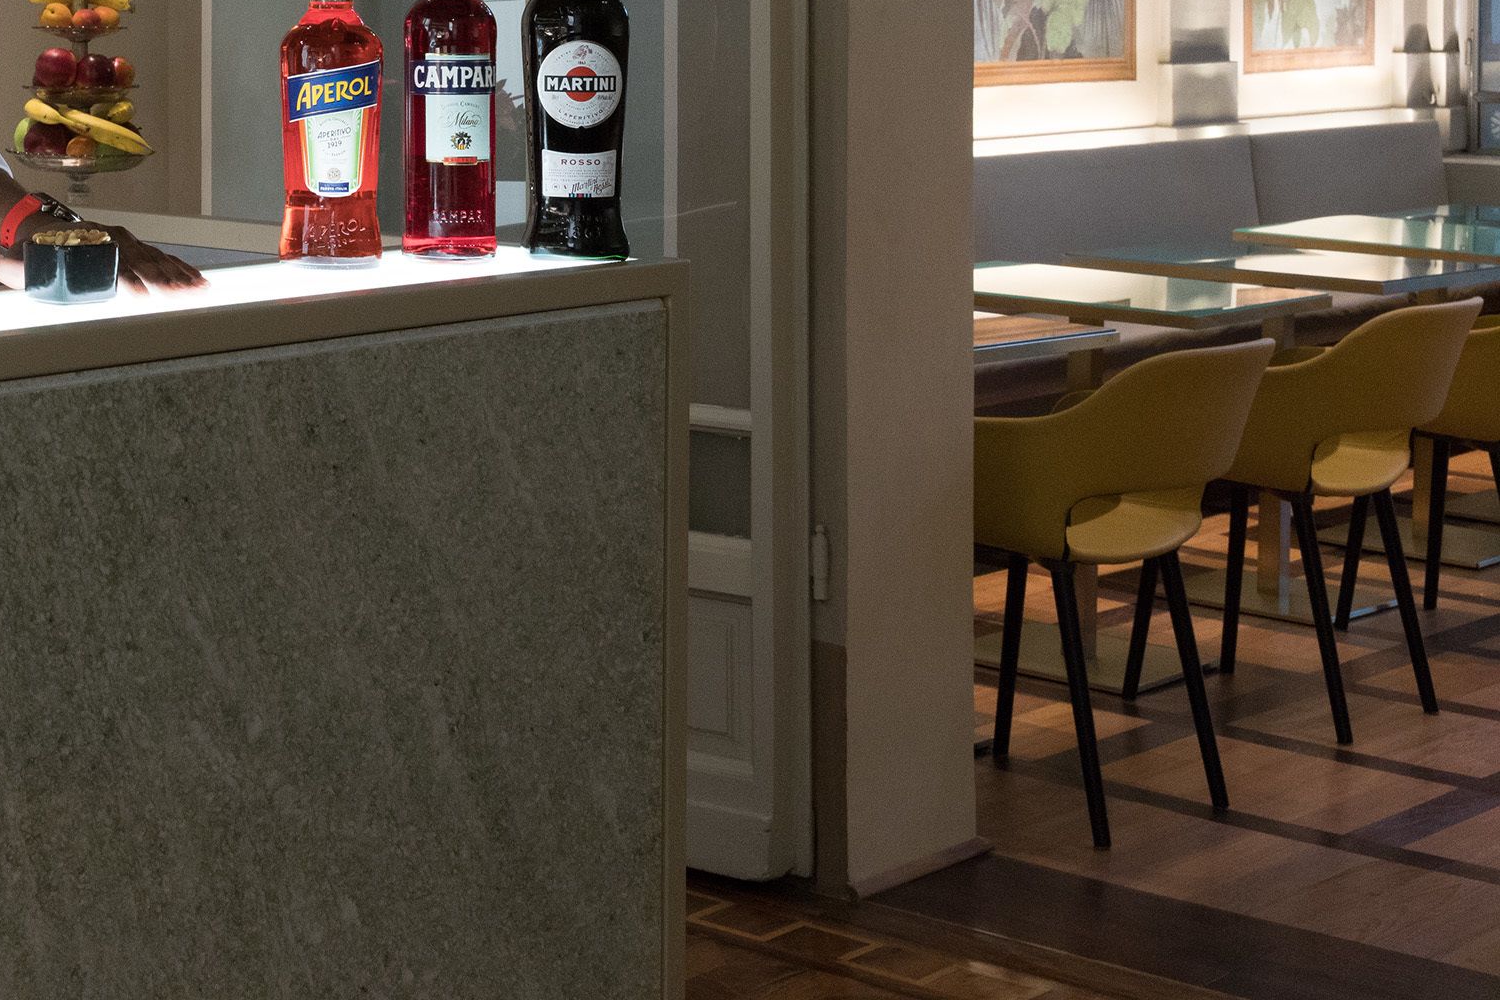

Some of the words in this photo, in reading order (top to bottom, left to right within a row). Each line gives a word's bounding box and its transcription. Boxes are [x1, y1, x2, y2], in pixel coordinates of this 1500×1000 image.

[414, 65, 496, 89] CAMPARI
[546, 77, 615, 91] MARTINI
[296, 76, 371, 112] APEROL
[317, 126, 352, 140] APERITIVO
